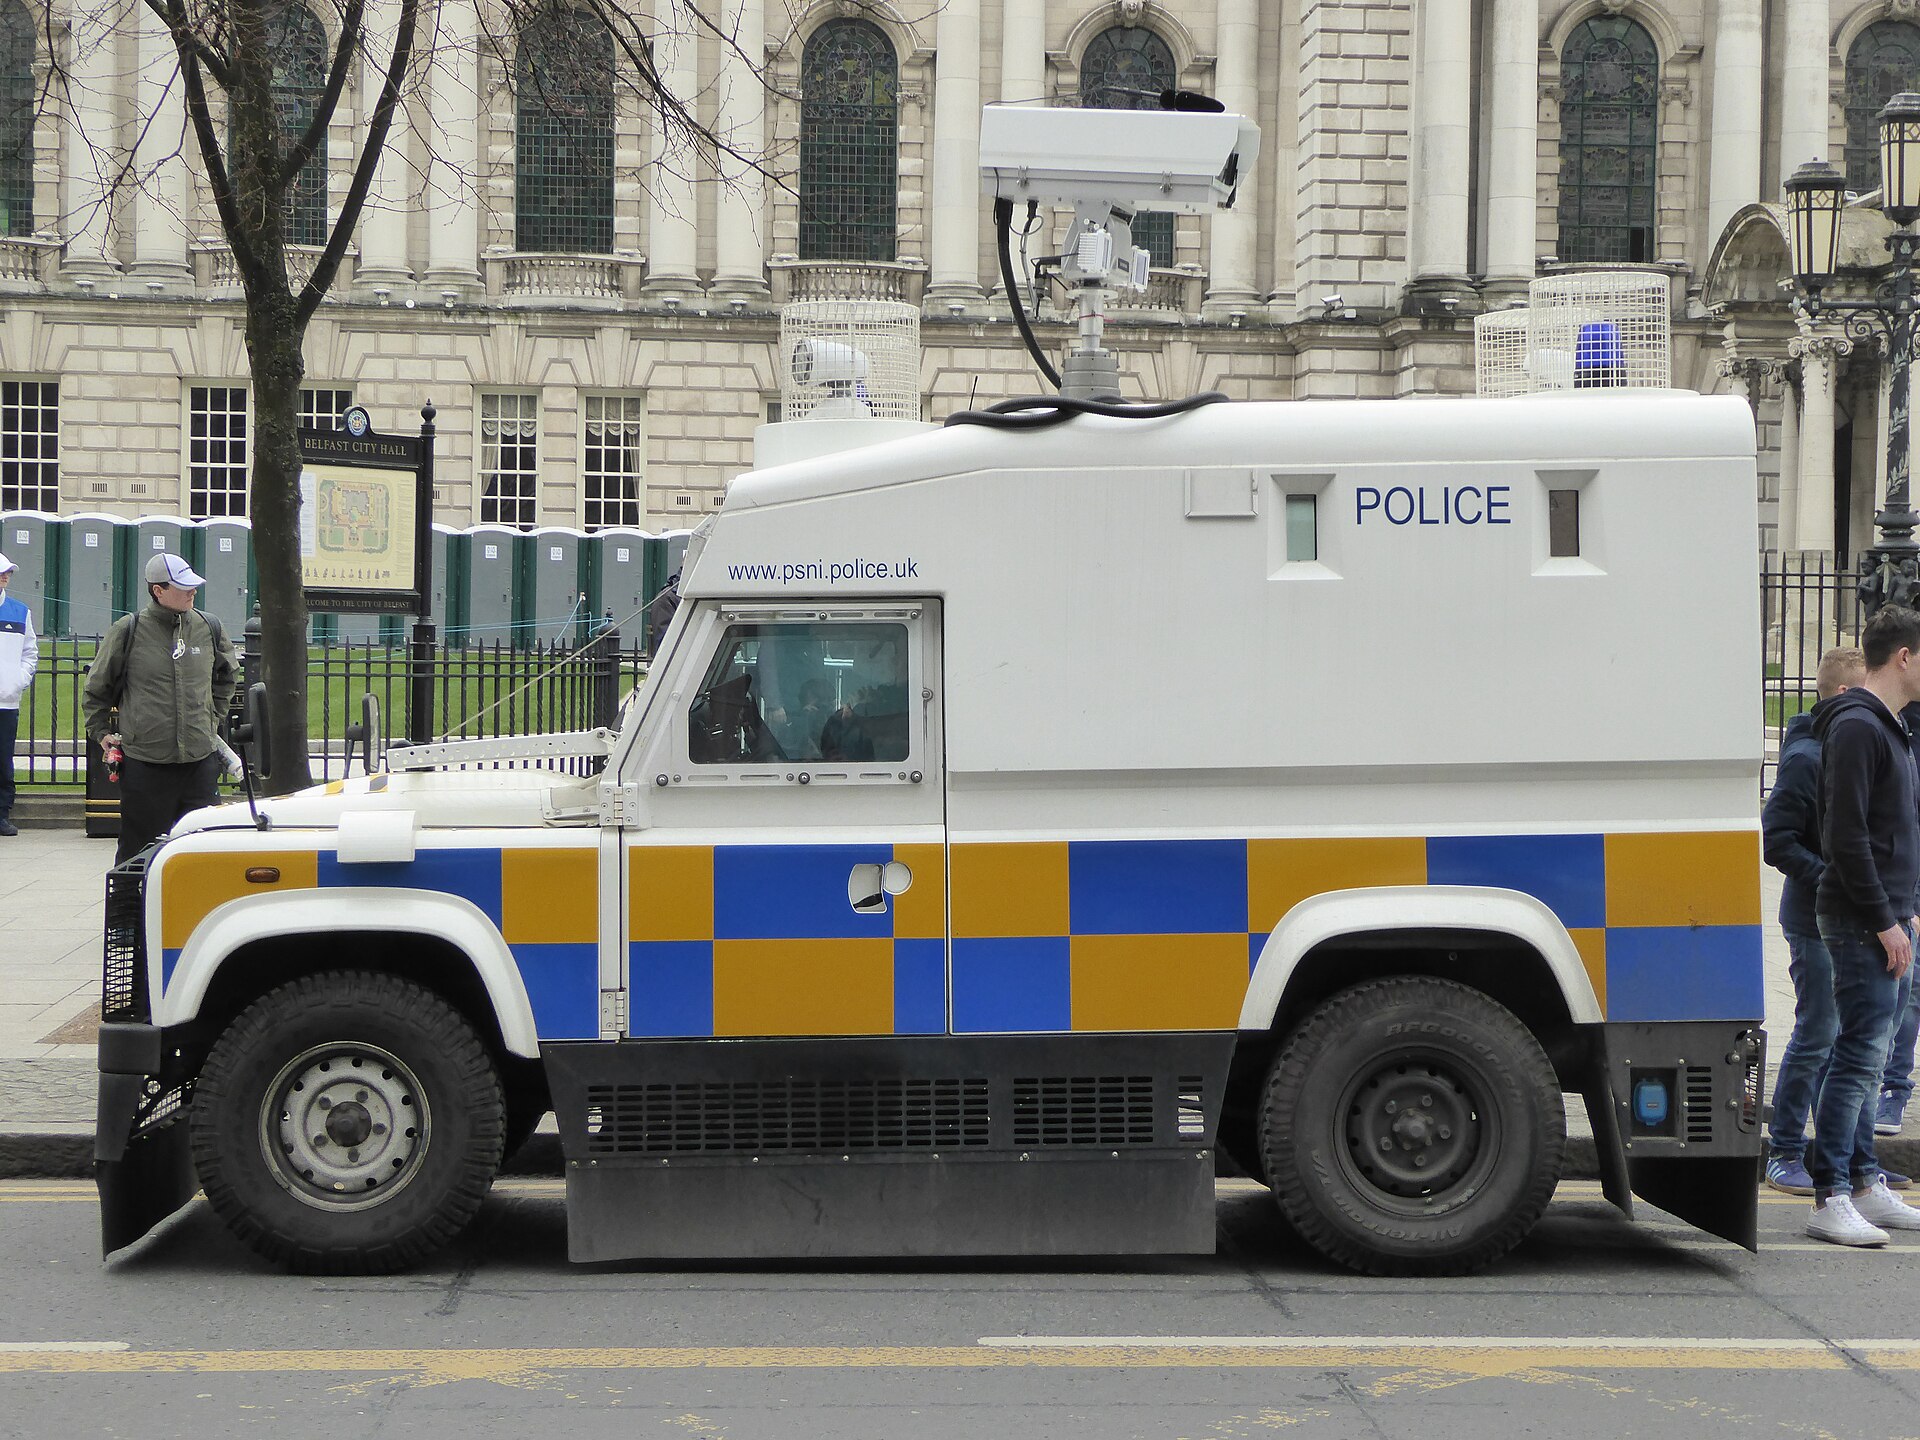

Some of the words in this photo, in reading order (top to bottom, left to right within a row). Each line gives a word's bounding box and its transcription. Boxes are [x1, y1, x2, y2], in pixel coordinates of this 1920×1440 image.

[304, 437, 349, 452] BELFAST
[352, 441, 377, 454] CITY
[380, 444, 407, 456] HALL
[1356, 486, 1512, 525] POLICE
[728, 557, 919, 585] www.psni.police.uk
[305, 599, 330, 607] LCOME
[356, 600, 372, 608] CITY
[373, 600, 382, 608] OF
[383, 601, 410, 609] BELFAST
